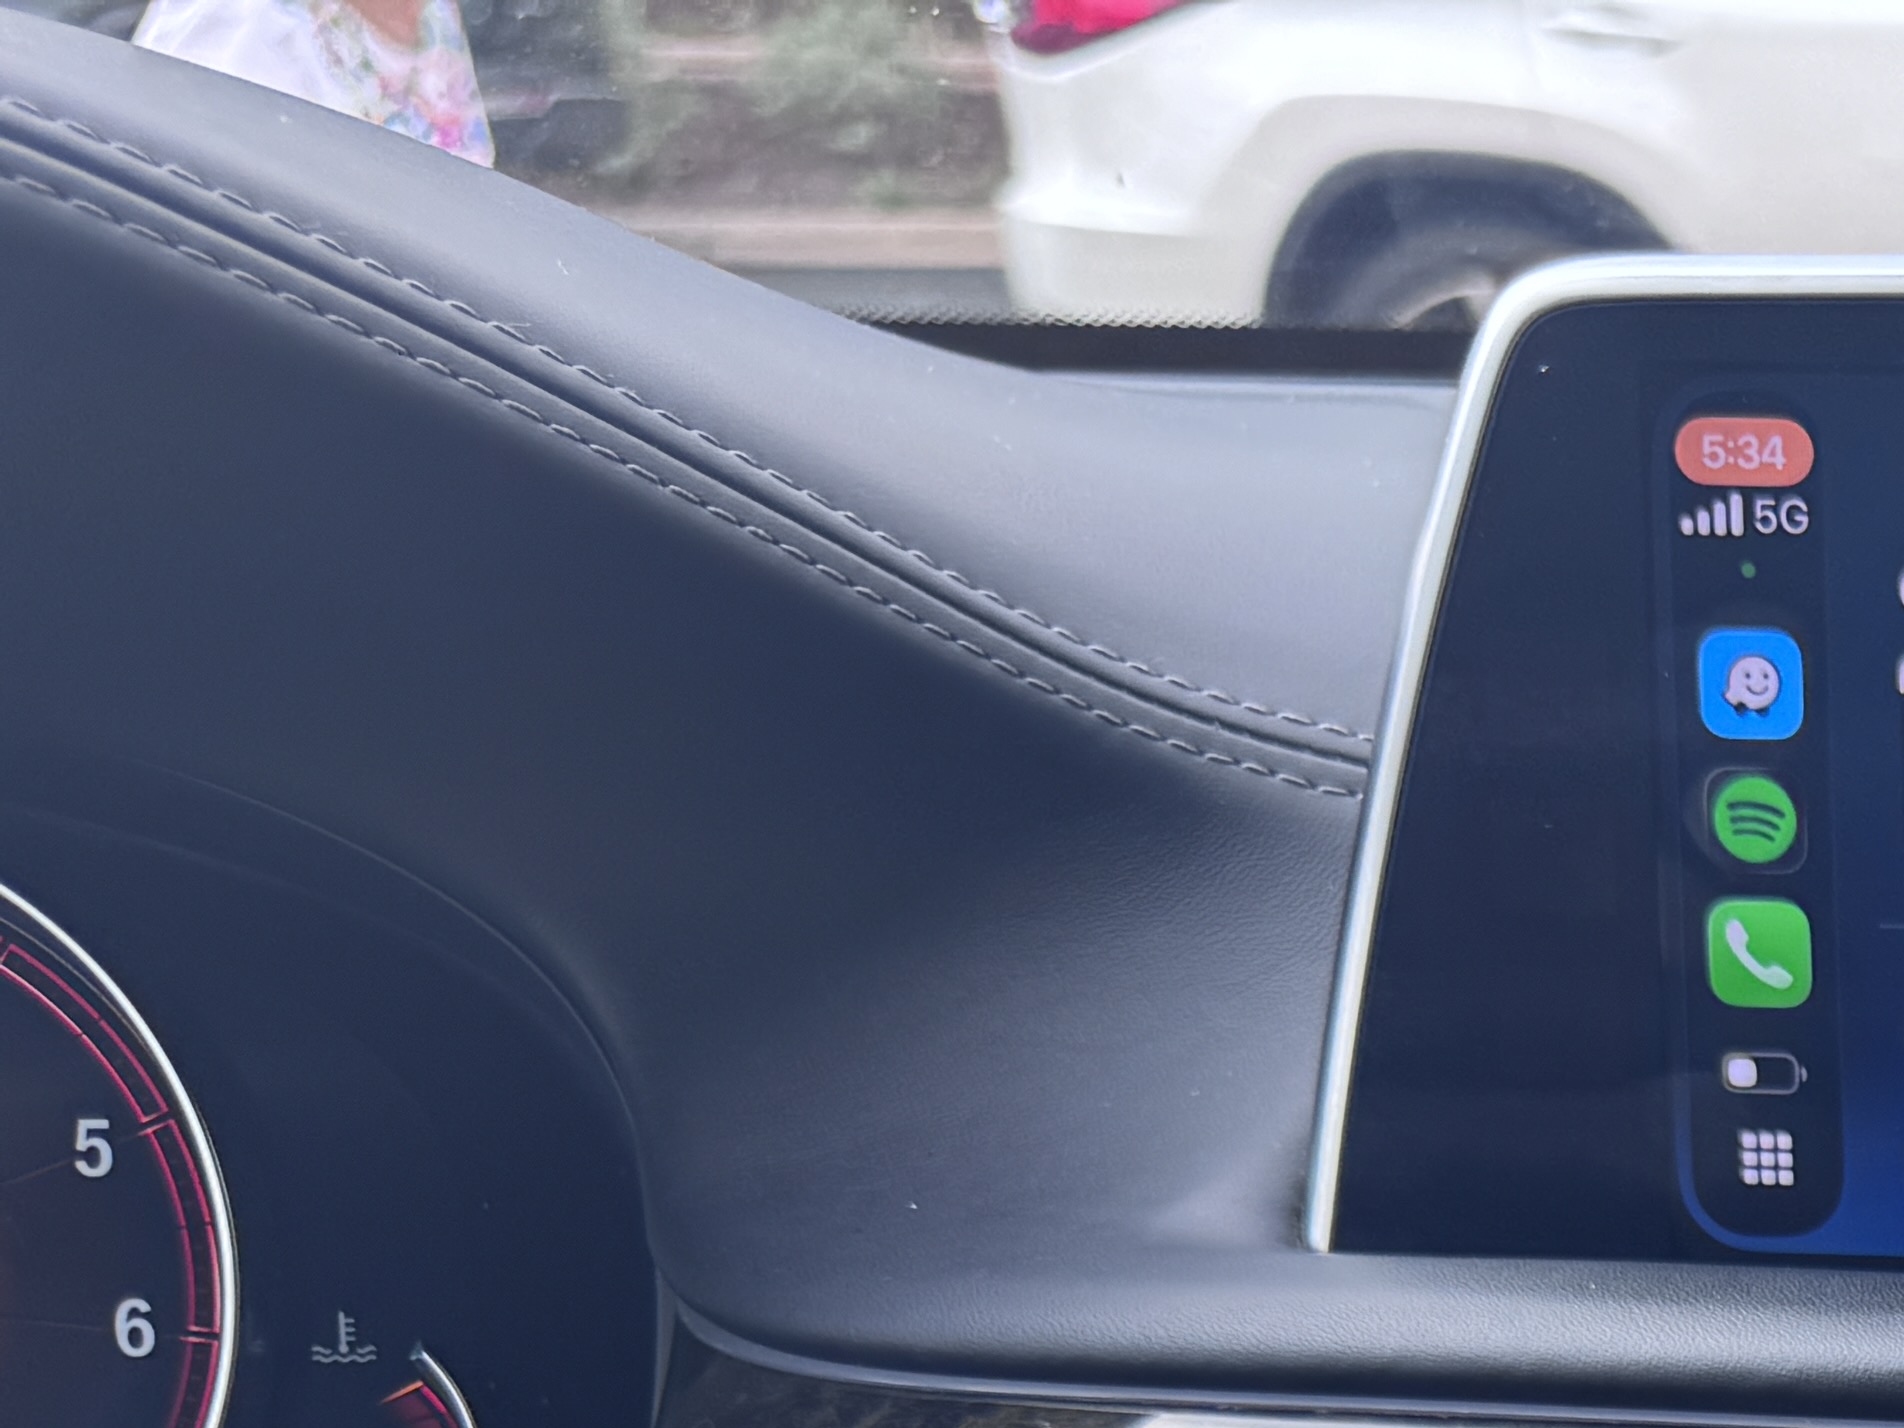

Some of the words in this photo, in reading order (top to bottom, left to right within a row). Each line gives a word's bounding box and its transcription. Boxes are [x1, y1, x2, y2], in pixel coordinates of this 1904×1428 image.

[1701, 434, 1786, 470] 5:34
[1753, 500, 1808, 535] 5G
[74, 1118, 113, 1178] 5
[114, 1298, 155, 1358] 6
